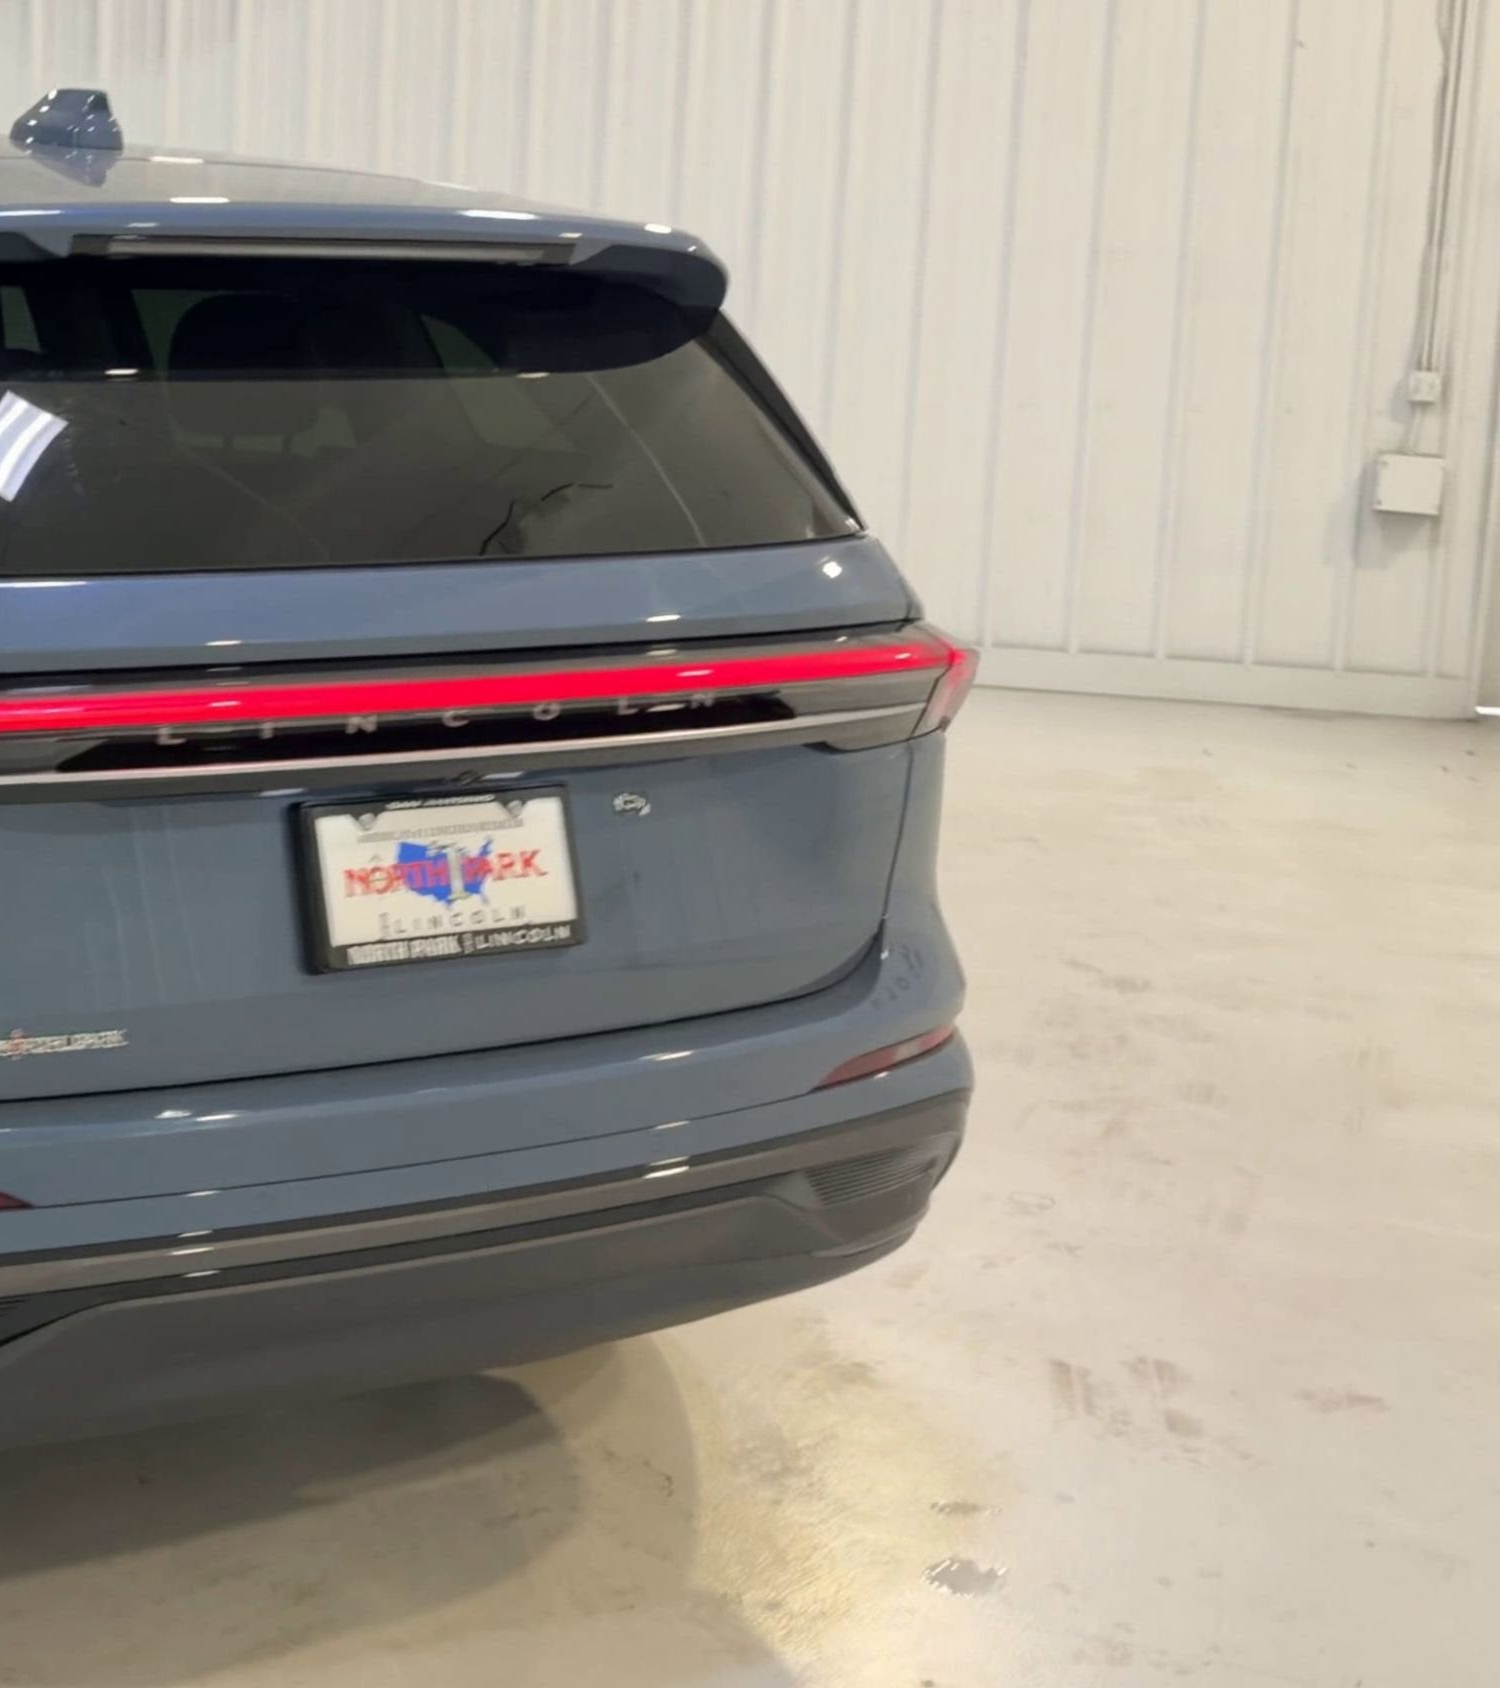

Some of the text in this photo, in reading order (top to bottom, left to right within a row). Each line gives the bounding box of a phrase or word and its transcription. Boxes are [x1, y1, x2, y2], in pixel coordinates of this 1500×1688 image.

[156, 691, 714, 746] LINCOLN
[344, 849, 548, 897] NORTH PARK
[393, 905, 526, 933] LINCOLN
[474, 924, 571, 949] LINCOLN
